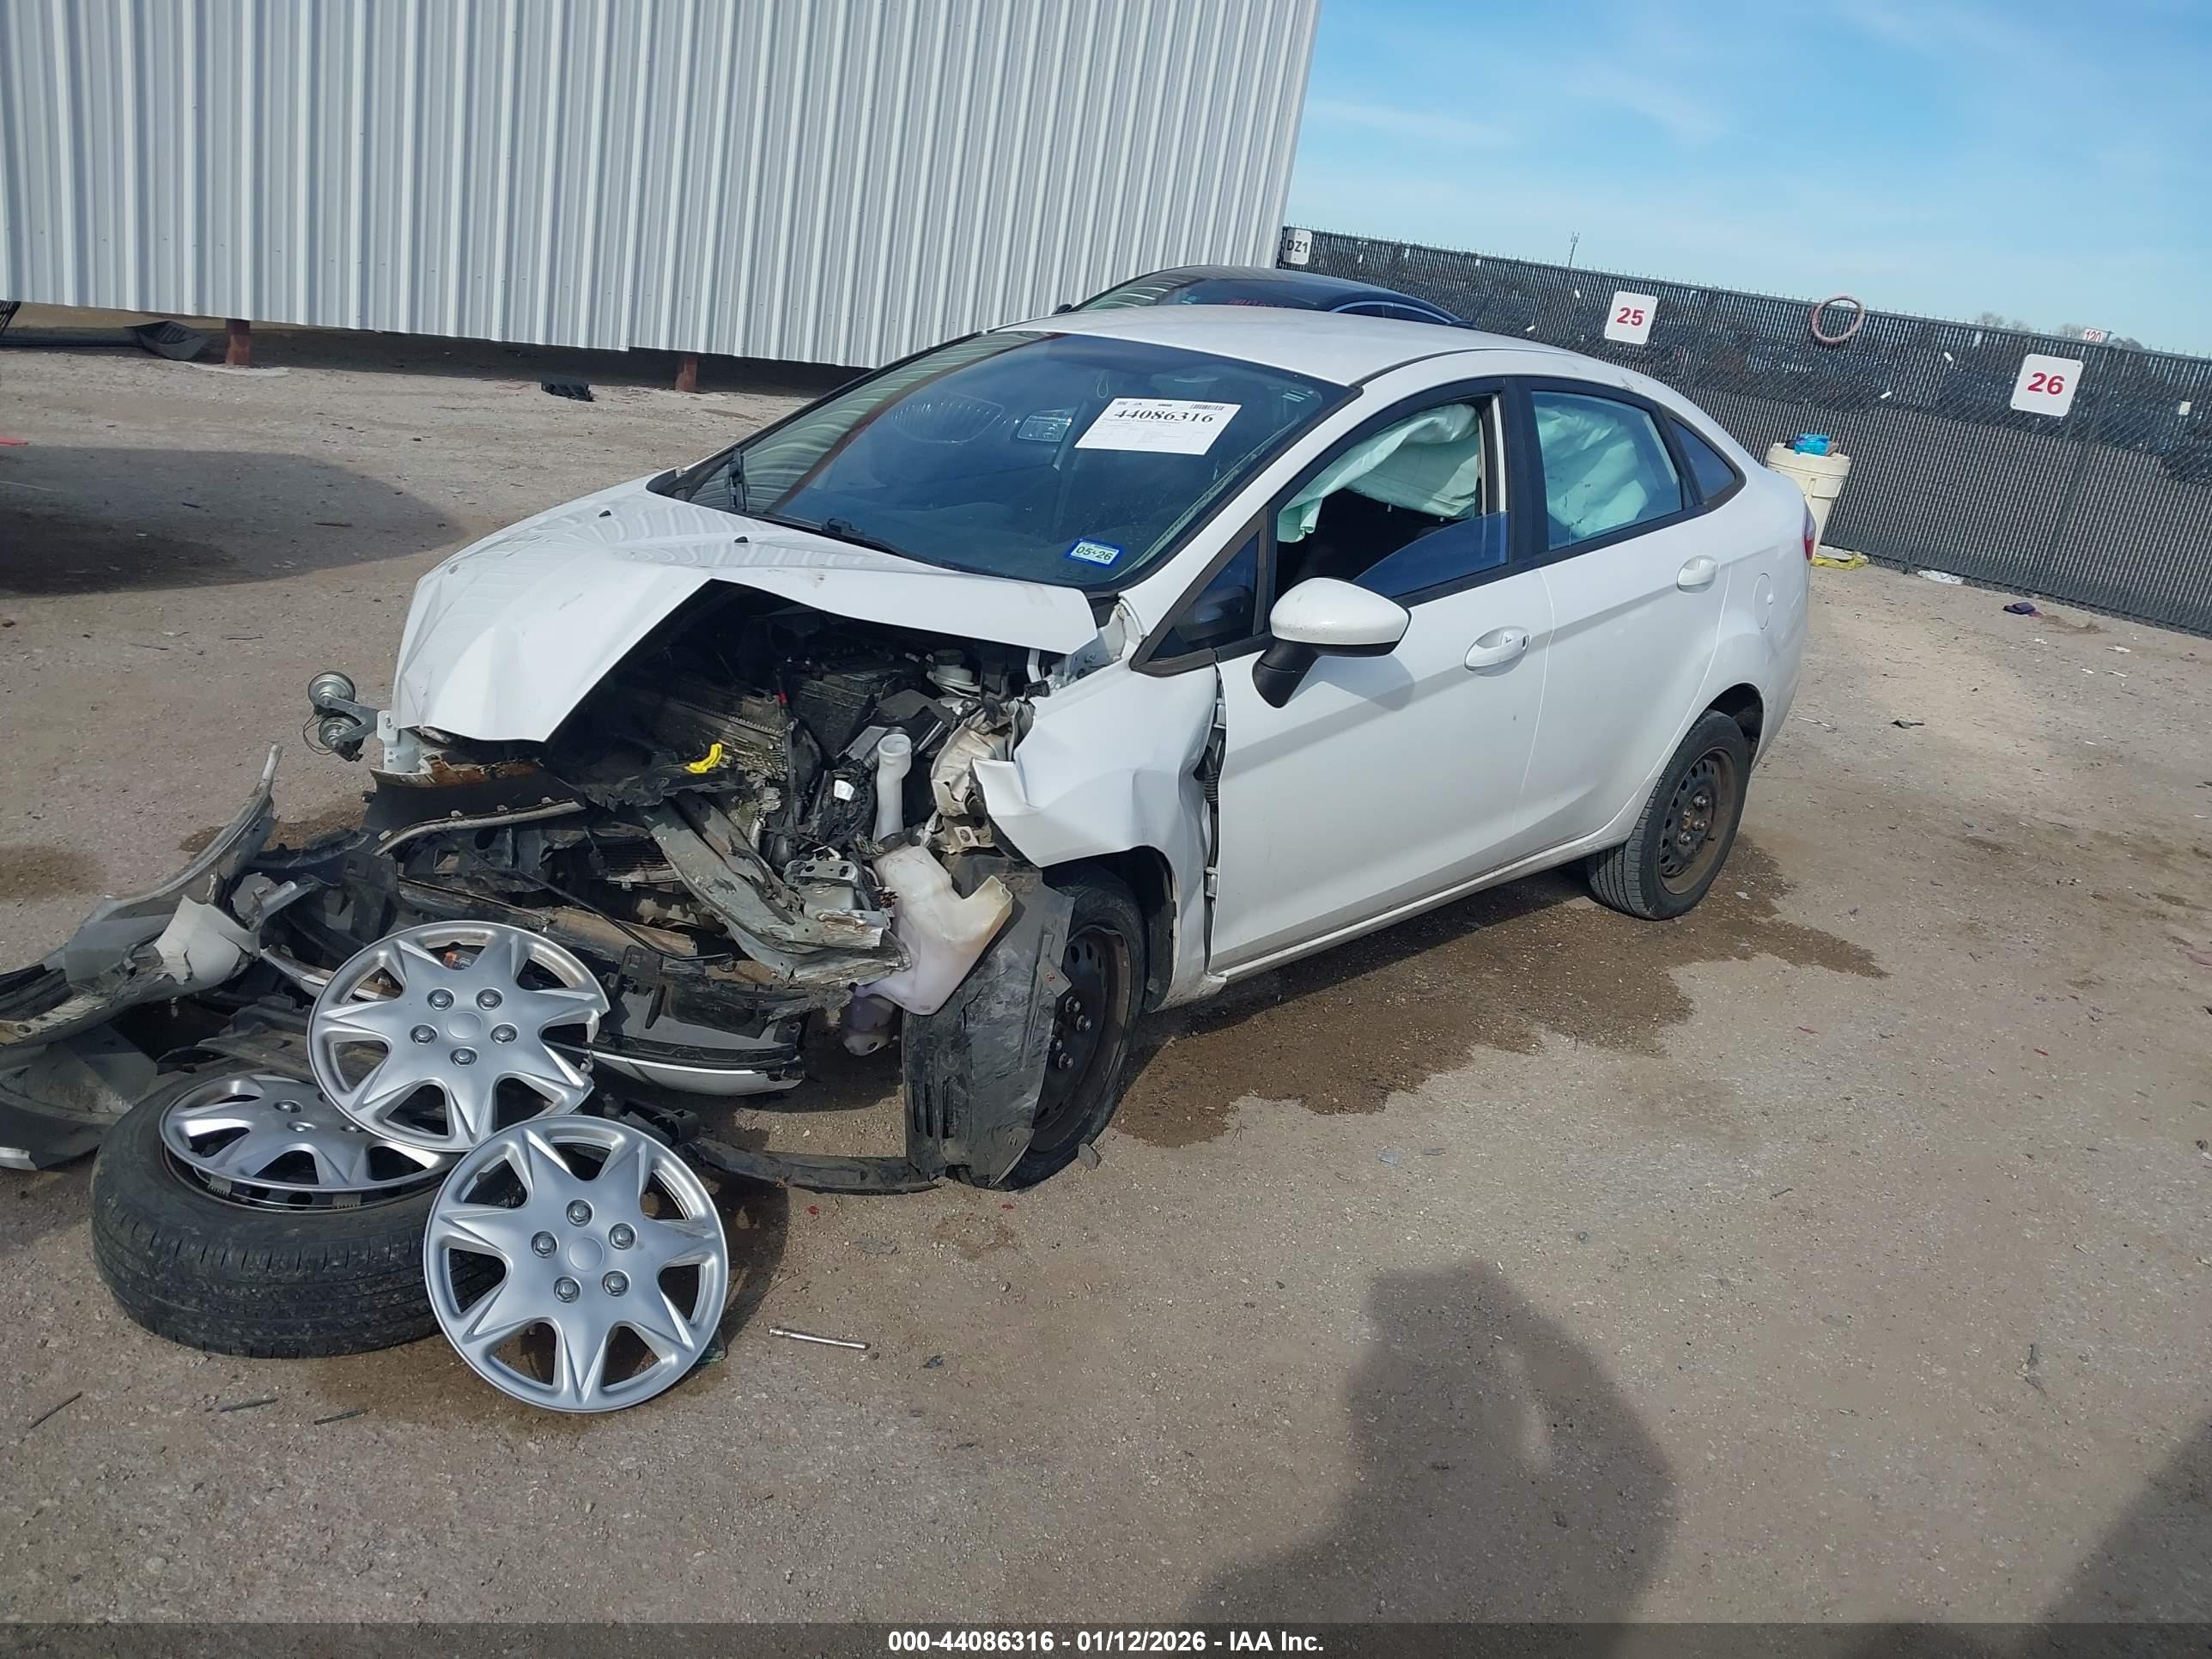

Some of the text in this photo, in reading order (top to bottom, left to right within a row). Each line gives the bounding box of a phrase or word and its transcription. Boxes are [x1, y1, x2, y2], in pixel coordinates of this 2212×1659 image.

[1286, 240, 1308, 253] DZ1
[1616, 307, 1644, 326] 25
[2027, 372, 2065, 395] 26
[1115, 409, 1216, 423] 44086316
